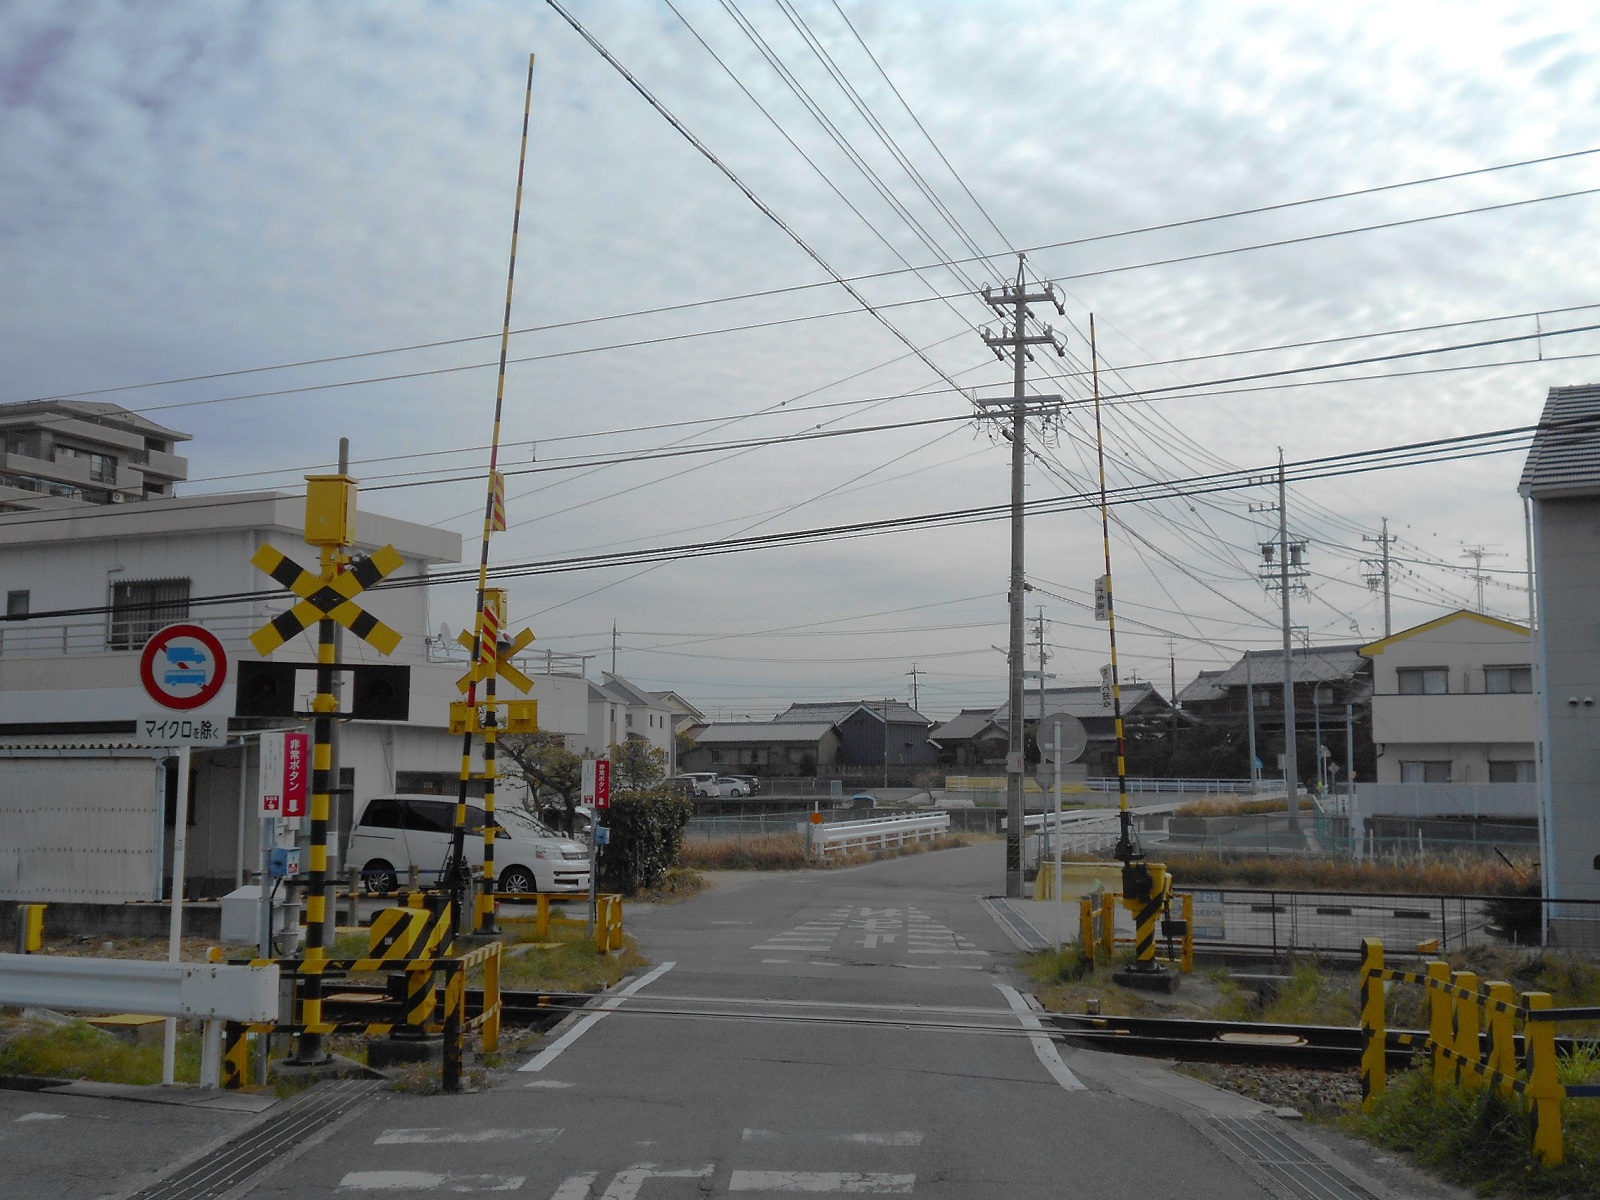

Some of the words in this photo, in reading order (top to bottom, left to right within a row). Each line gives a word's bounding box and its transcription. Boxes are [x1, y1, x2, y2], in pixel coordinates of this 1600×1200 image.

[144, 719, 219, 740] マイクロを除く
[289, 738, 301, 792] 非常ボタン
